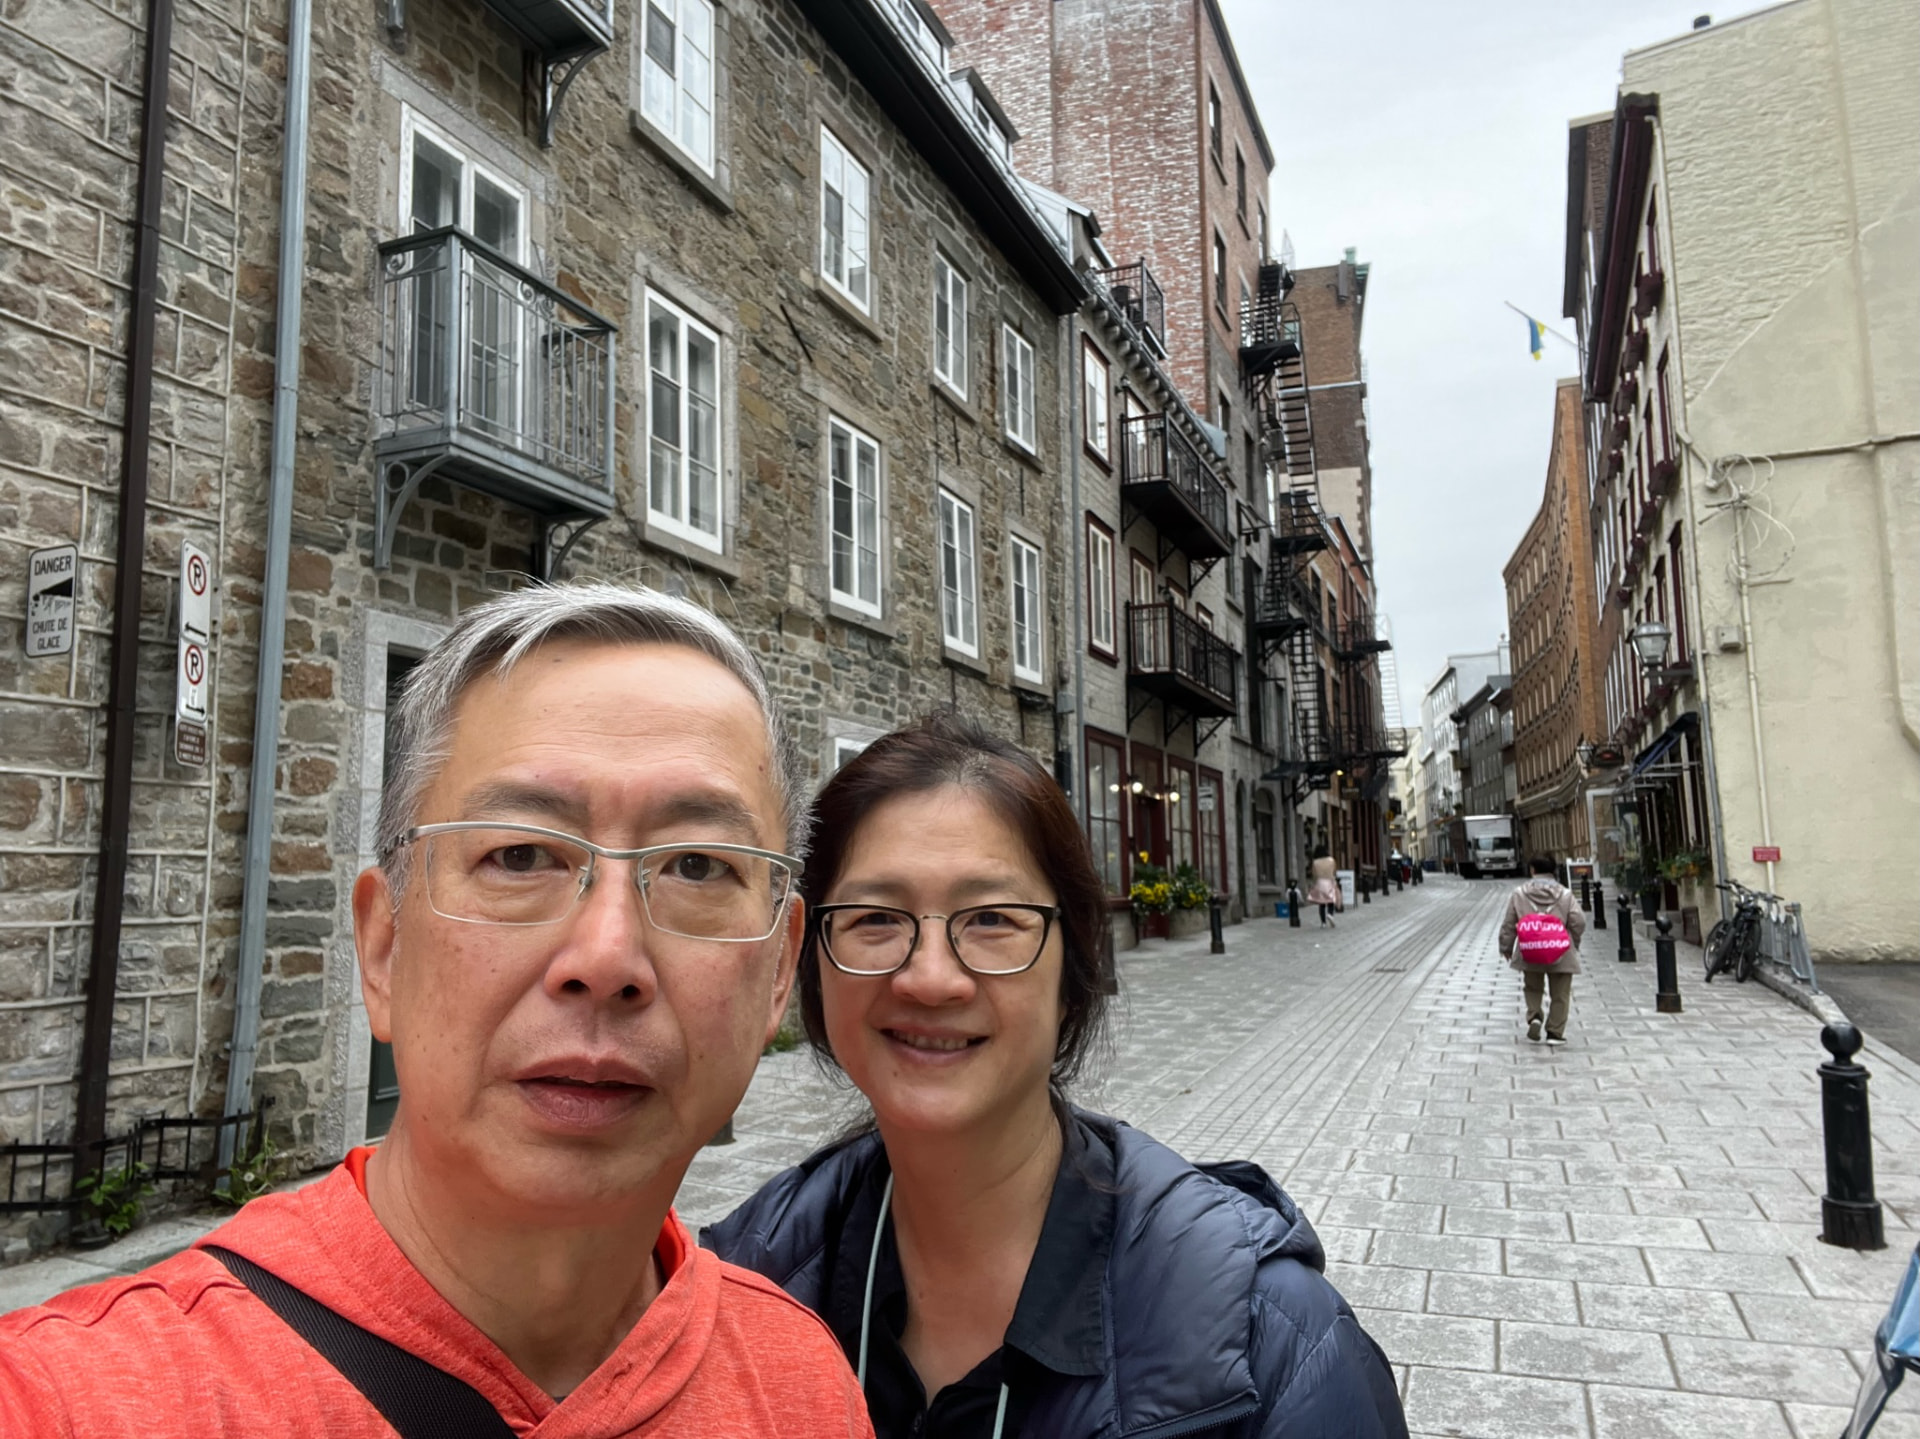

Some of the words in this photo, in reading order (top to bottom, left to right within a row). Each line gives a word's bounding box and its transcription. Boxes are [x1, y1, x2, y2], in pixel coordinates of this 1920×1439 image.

[34, 555, 72, 576] DANGER
[32, 619, 56, 634] CHUTE
[58, 617, 68, 631] DE
[37, 635, 61, 650] GLACE
